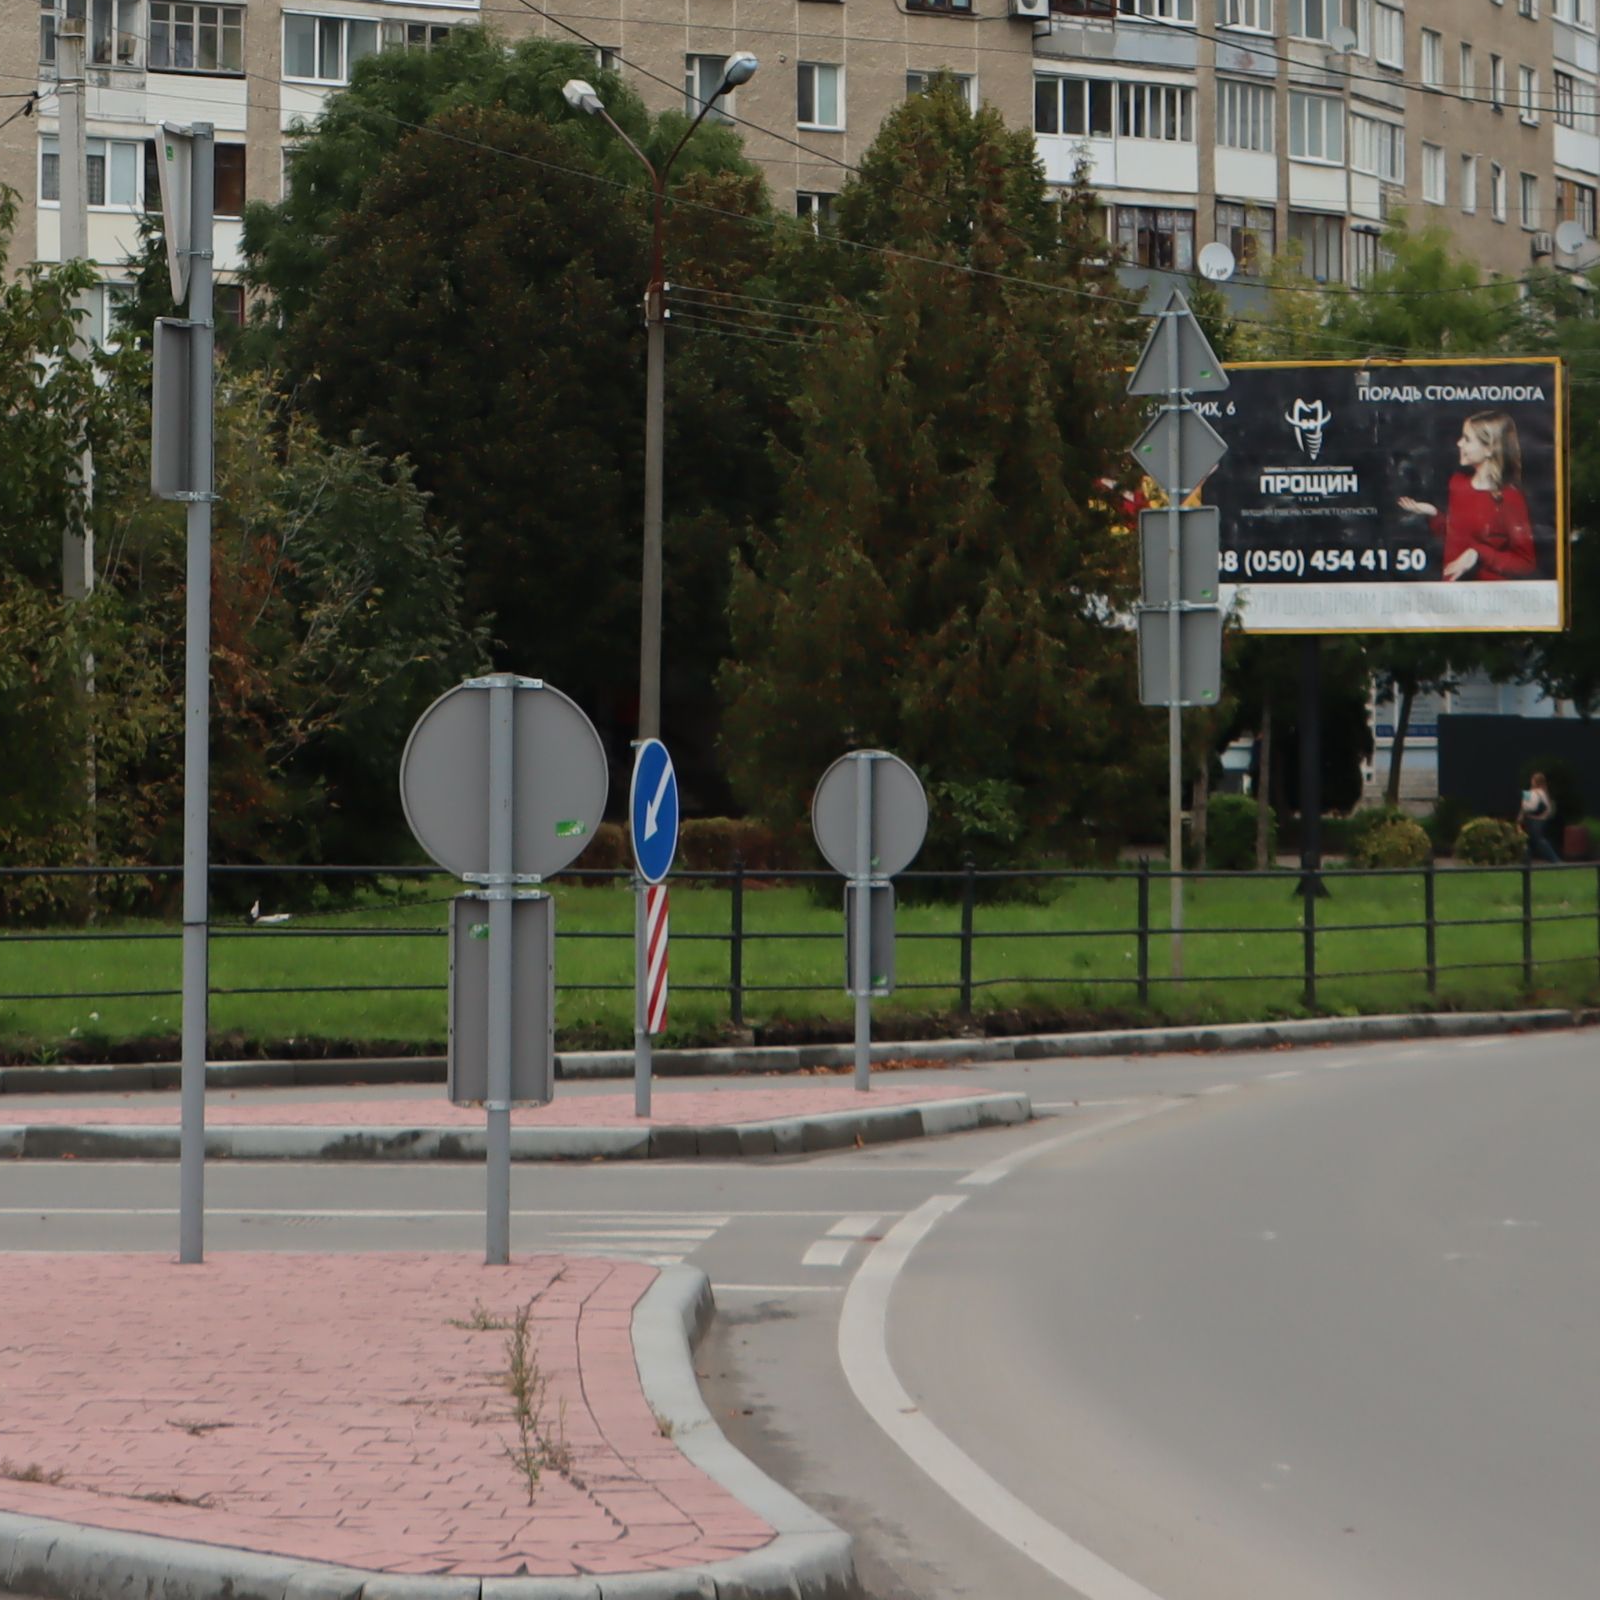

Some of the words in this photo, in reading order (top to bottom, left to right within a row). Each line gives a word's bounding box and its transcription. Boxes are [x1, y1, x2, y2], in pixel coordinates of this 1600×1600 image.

[1358, 385, 1422, 403] ПОРАДЬ
[1424, 385, 1545, 402] СТОМАТОЛОГА
[1226, 401, 1236, 416] 6
[1260, 474, 1358, 495] ПРОЩИН
[1244, 550, 1305, 576] (050)
[1310, 550, 1355, 571] 454
[1360, 550, 1388, 570] 41
[1396, 548, 1426, 570] 50
